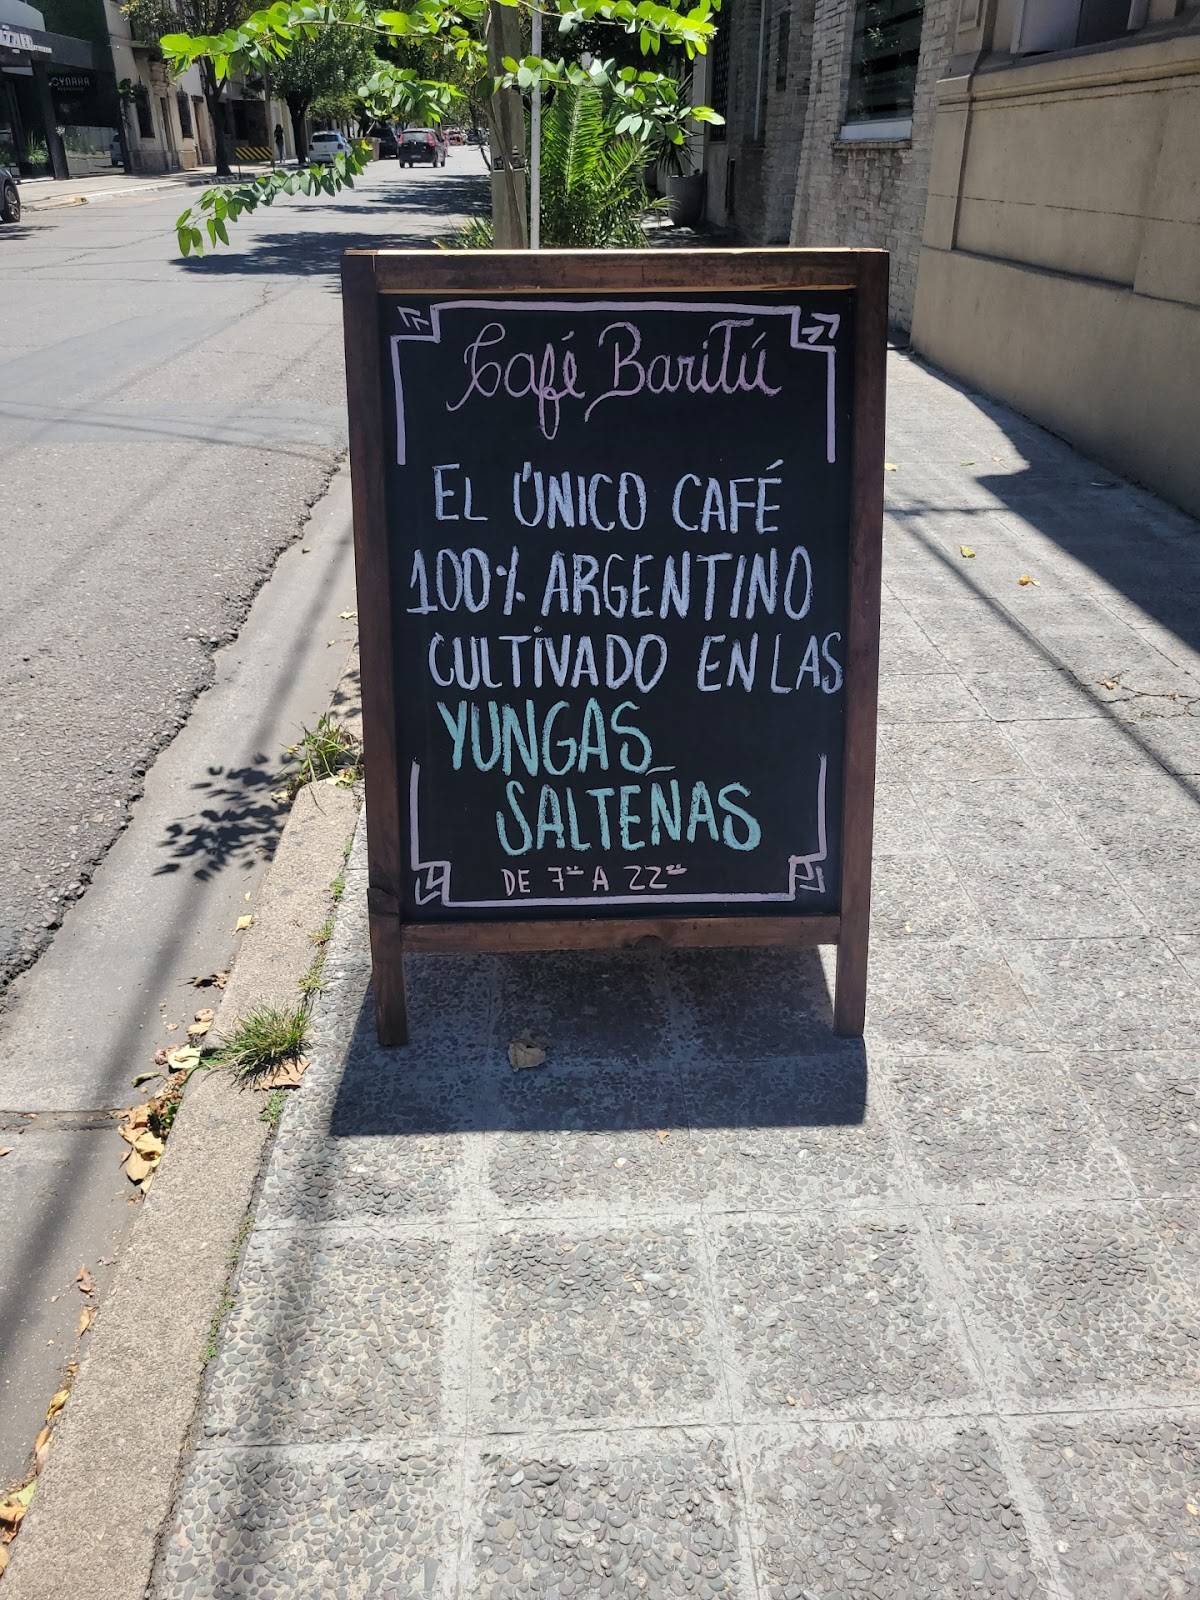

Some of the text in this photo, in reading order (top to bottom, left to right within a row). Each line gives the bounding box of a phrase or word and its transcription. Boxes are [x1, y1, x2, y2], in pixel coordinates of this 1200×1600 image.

[446, 322, 586, 440] Café
[432, 459, 784, 534] EL ÚNICO CAFÉ
[406, 545, 813, 621] 100% ARGENTINO
[428, 625, 668, 694] CULTIVADO
[436, 698, 652, 776] YUNGAS
[495, 765, 762, 856] SALTEÑAS
[500, 868, 531, 896] DE
[592, 865, 610, 891] A
